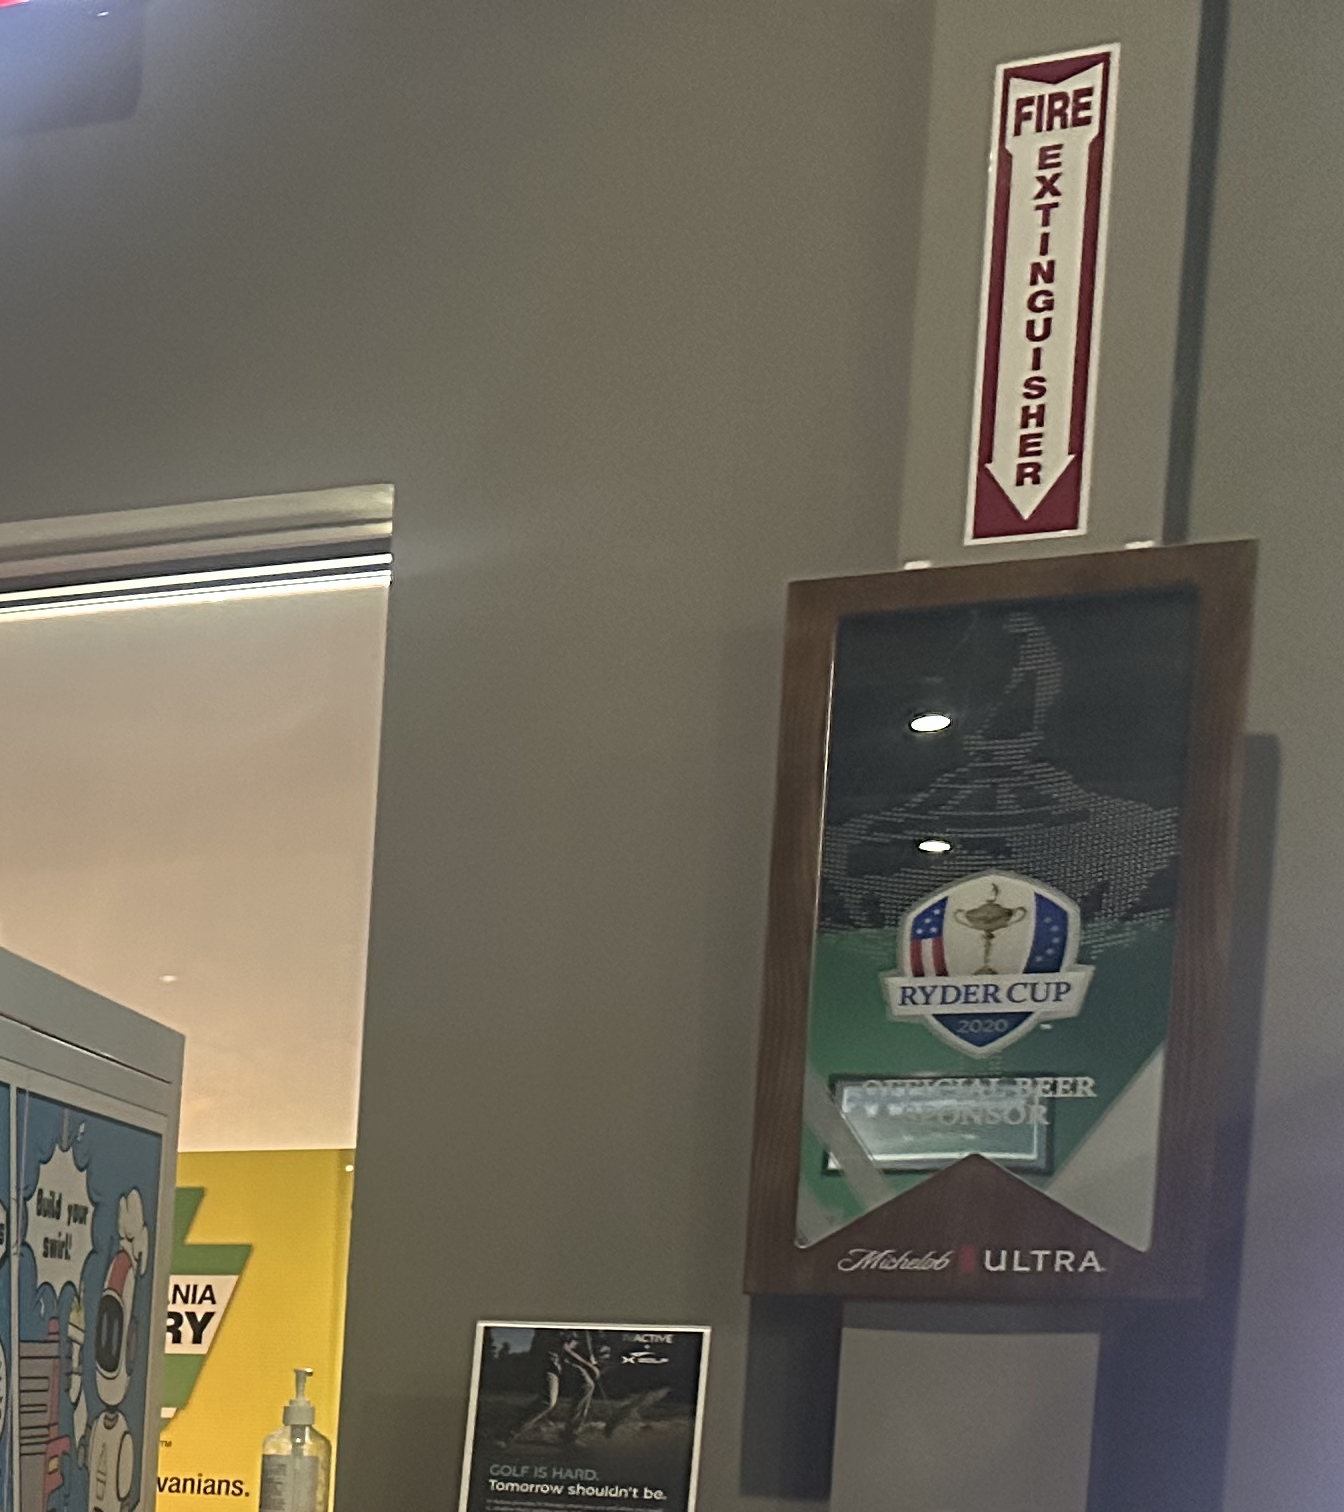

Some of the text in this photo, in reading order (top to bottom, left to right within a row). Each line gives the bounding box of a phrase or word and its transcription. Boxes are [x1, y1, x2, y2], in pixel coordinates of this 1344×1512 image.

[1013, 86, 1095, 137] FIRE
[1015, 143, 1065, 487] EXTINGUISHER
[898, 981, 1073, 1007] RYDER CUP
[957, 1018, 1010, 1035] 2020
[1016, 1076, 1098, 1098] BEER
[35, 1188, 89, 1228] Build your
[42, 1232, 73, 1261] swirl!
[837, 1247, 1105, 1273] Michelob ULTRA
[167, 1283, 218, 1306] NIA
[489, 1464, 600, 1482] GOLF IS HARD.
[488, 1479, 668, 1500] Tomorrow shouldn't be.
